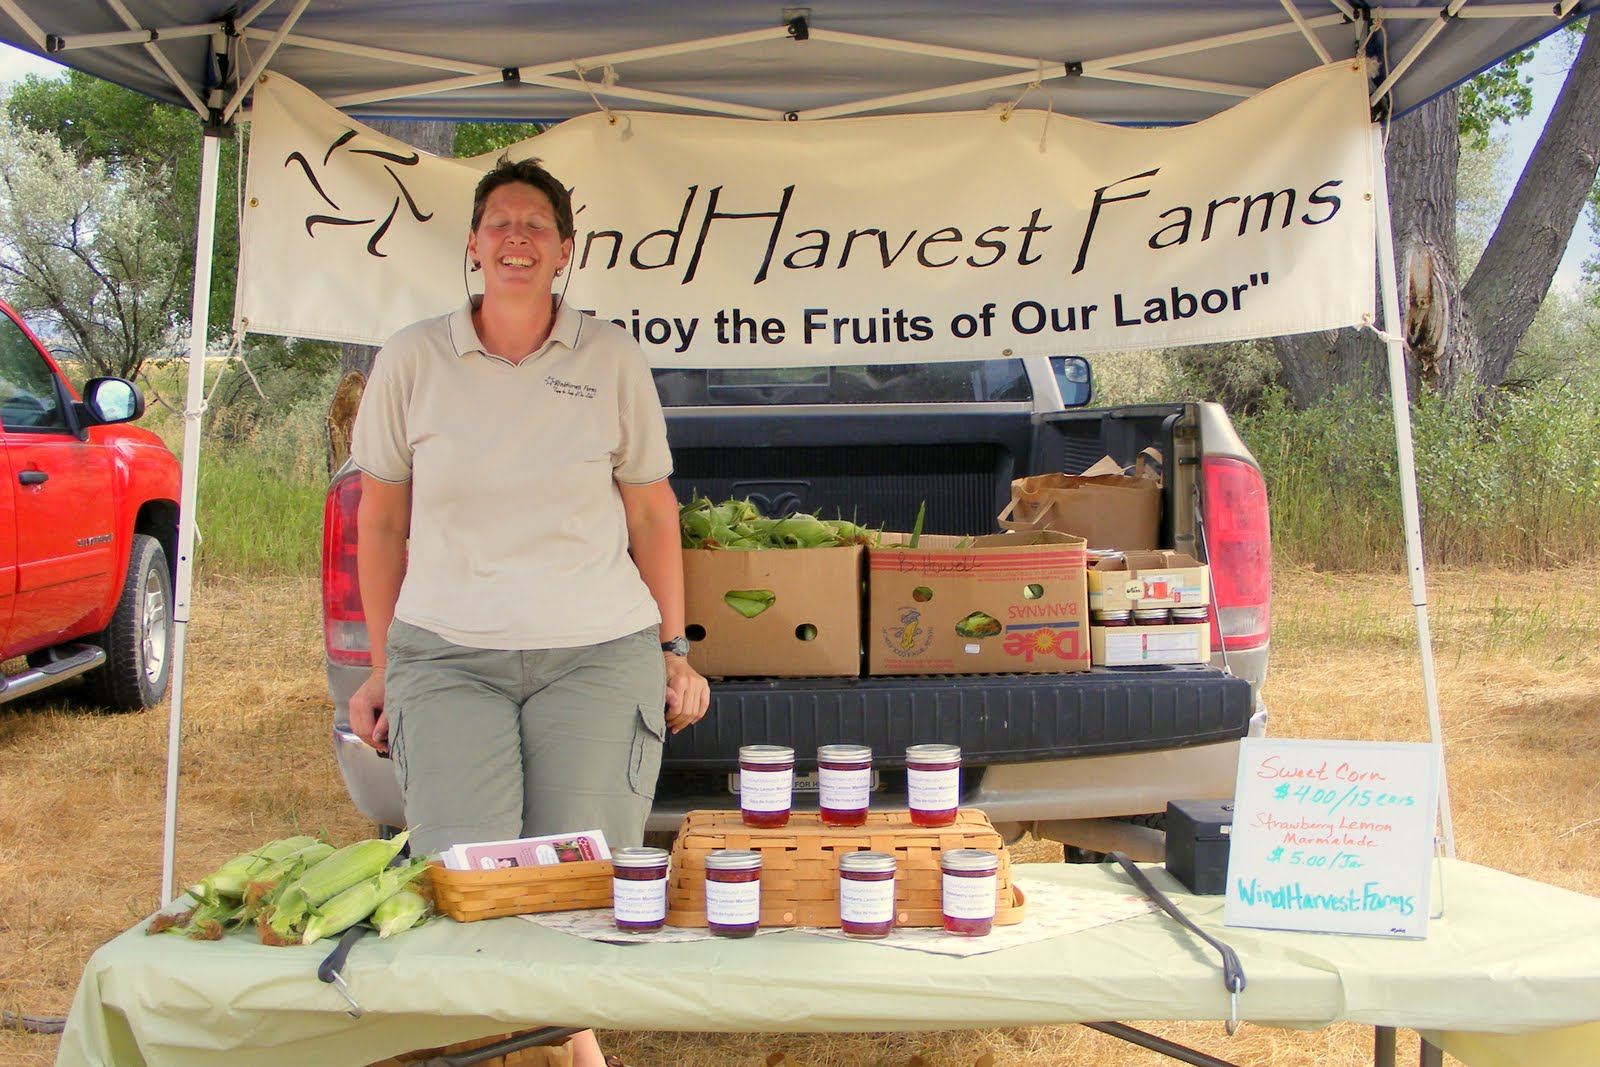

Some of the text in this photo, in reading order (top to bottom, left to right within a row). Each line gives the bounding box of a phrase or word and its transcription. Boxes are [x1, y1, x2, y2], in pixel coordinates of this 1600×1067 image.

[568, 167, 1343, 285] ndHarvest Farms
[578, 271, 1269, 353] joy the Fruits of Our Labor"
[1008, 602, 1077, 619] BANANAS
[1003, 628, 1079, 663] Dole
[1257, 755, 1386, 783] Sweet Corn
[1250, 812, 1392, 838] Strawberry Lemon
[1283, 832, 1379, 847] Marmalade
